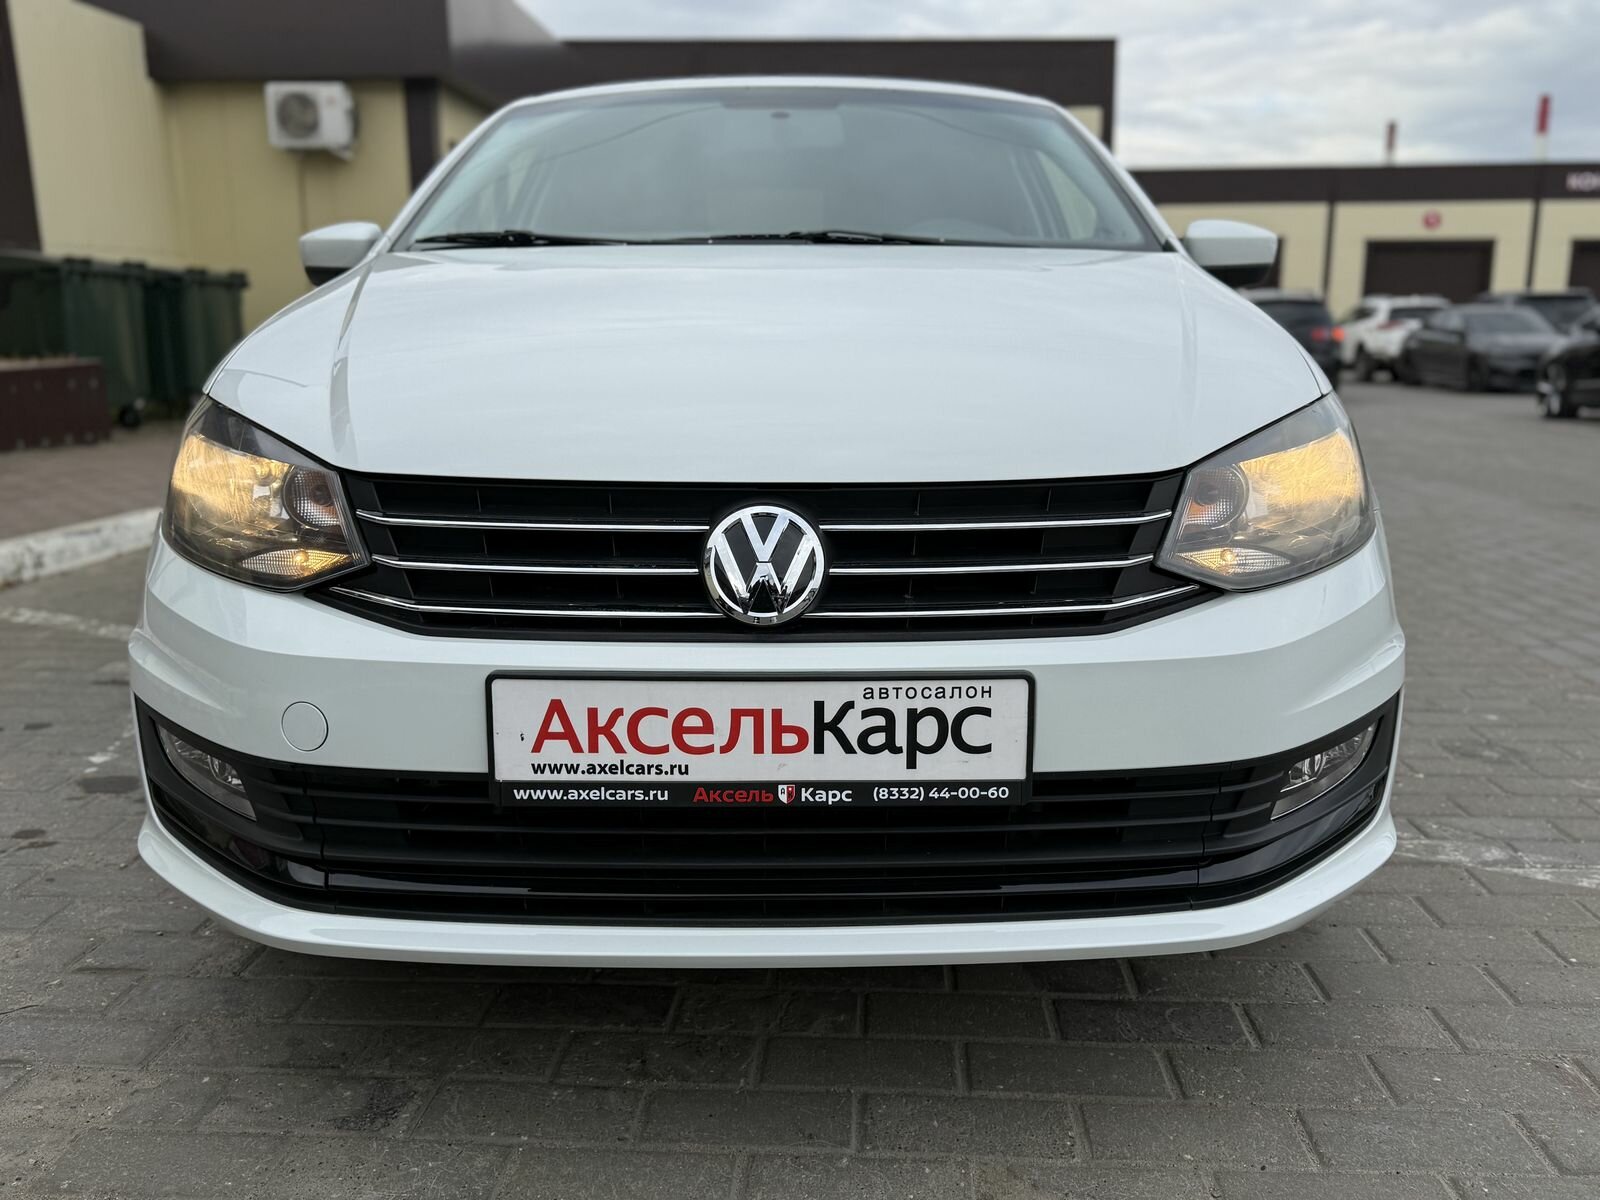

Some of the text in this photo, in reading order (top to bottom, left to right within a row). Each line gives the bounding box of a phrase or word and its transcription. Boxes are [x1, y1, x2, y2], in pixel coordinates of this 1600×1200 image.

[862, 685, 993, 700] автосалон
[530, 759, 690, 776] www.axelcars.ru
[512, 785, 670, 801] www.axelcars.ru
[693, 787, 775, 803] Аксель
[801, 787, 853, 805] Карс
[873, 785, 1010, 801] (8332) 44-00-60
